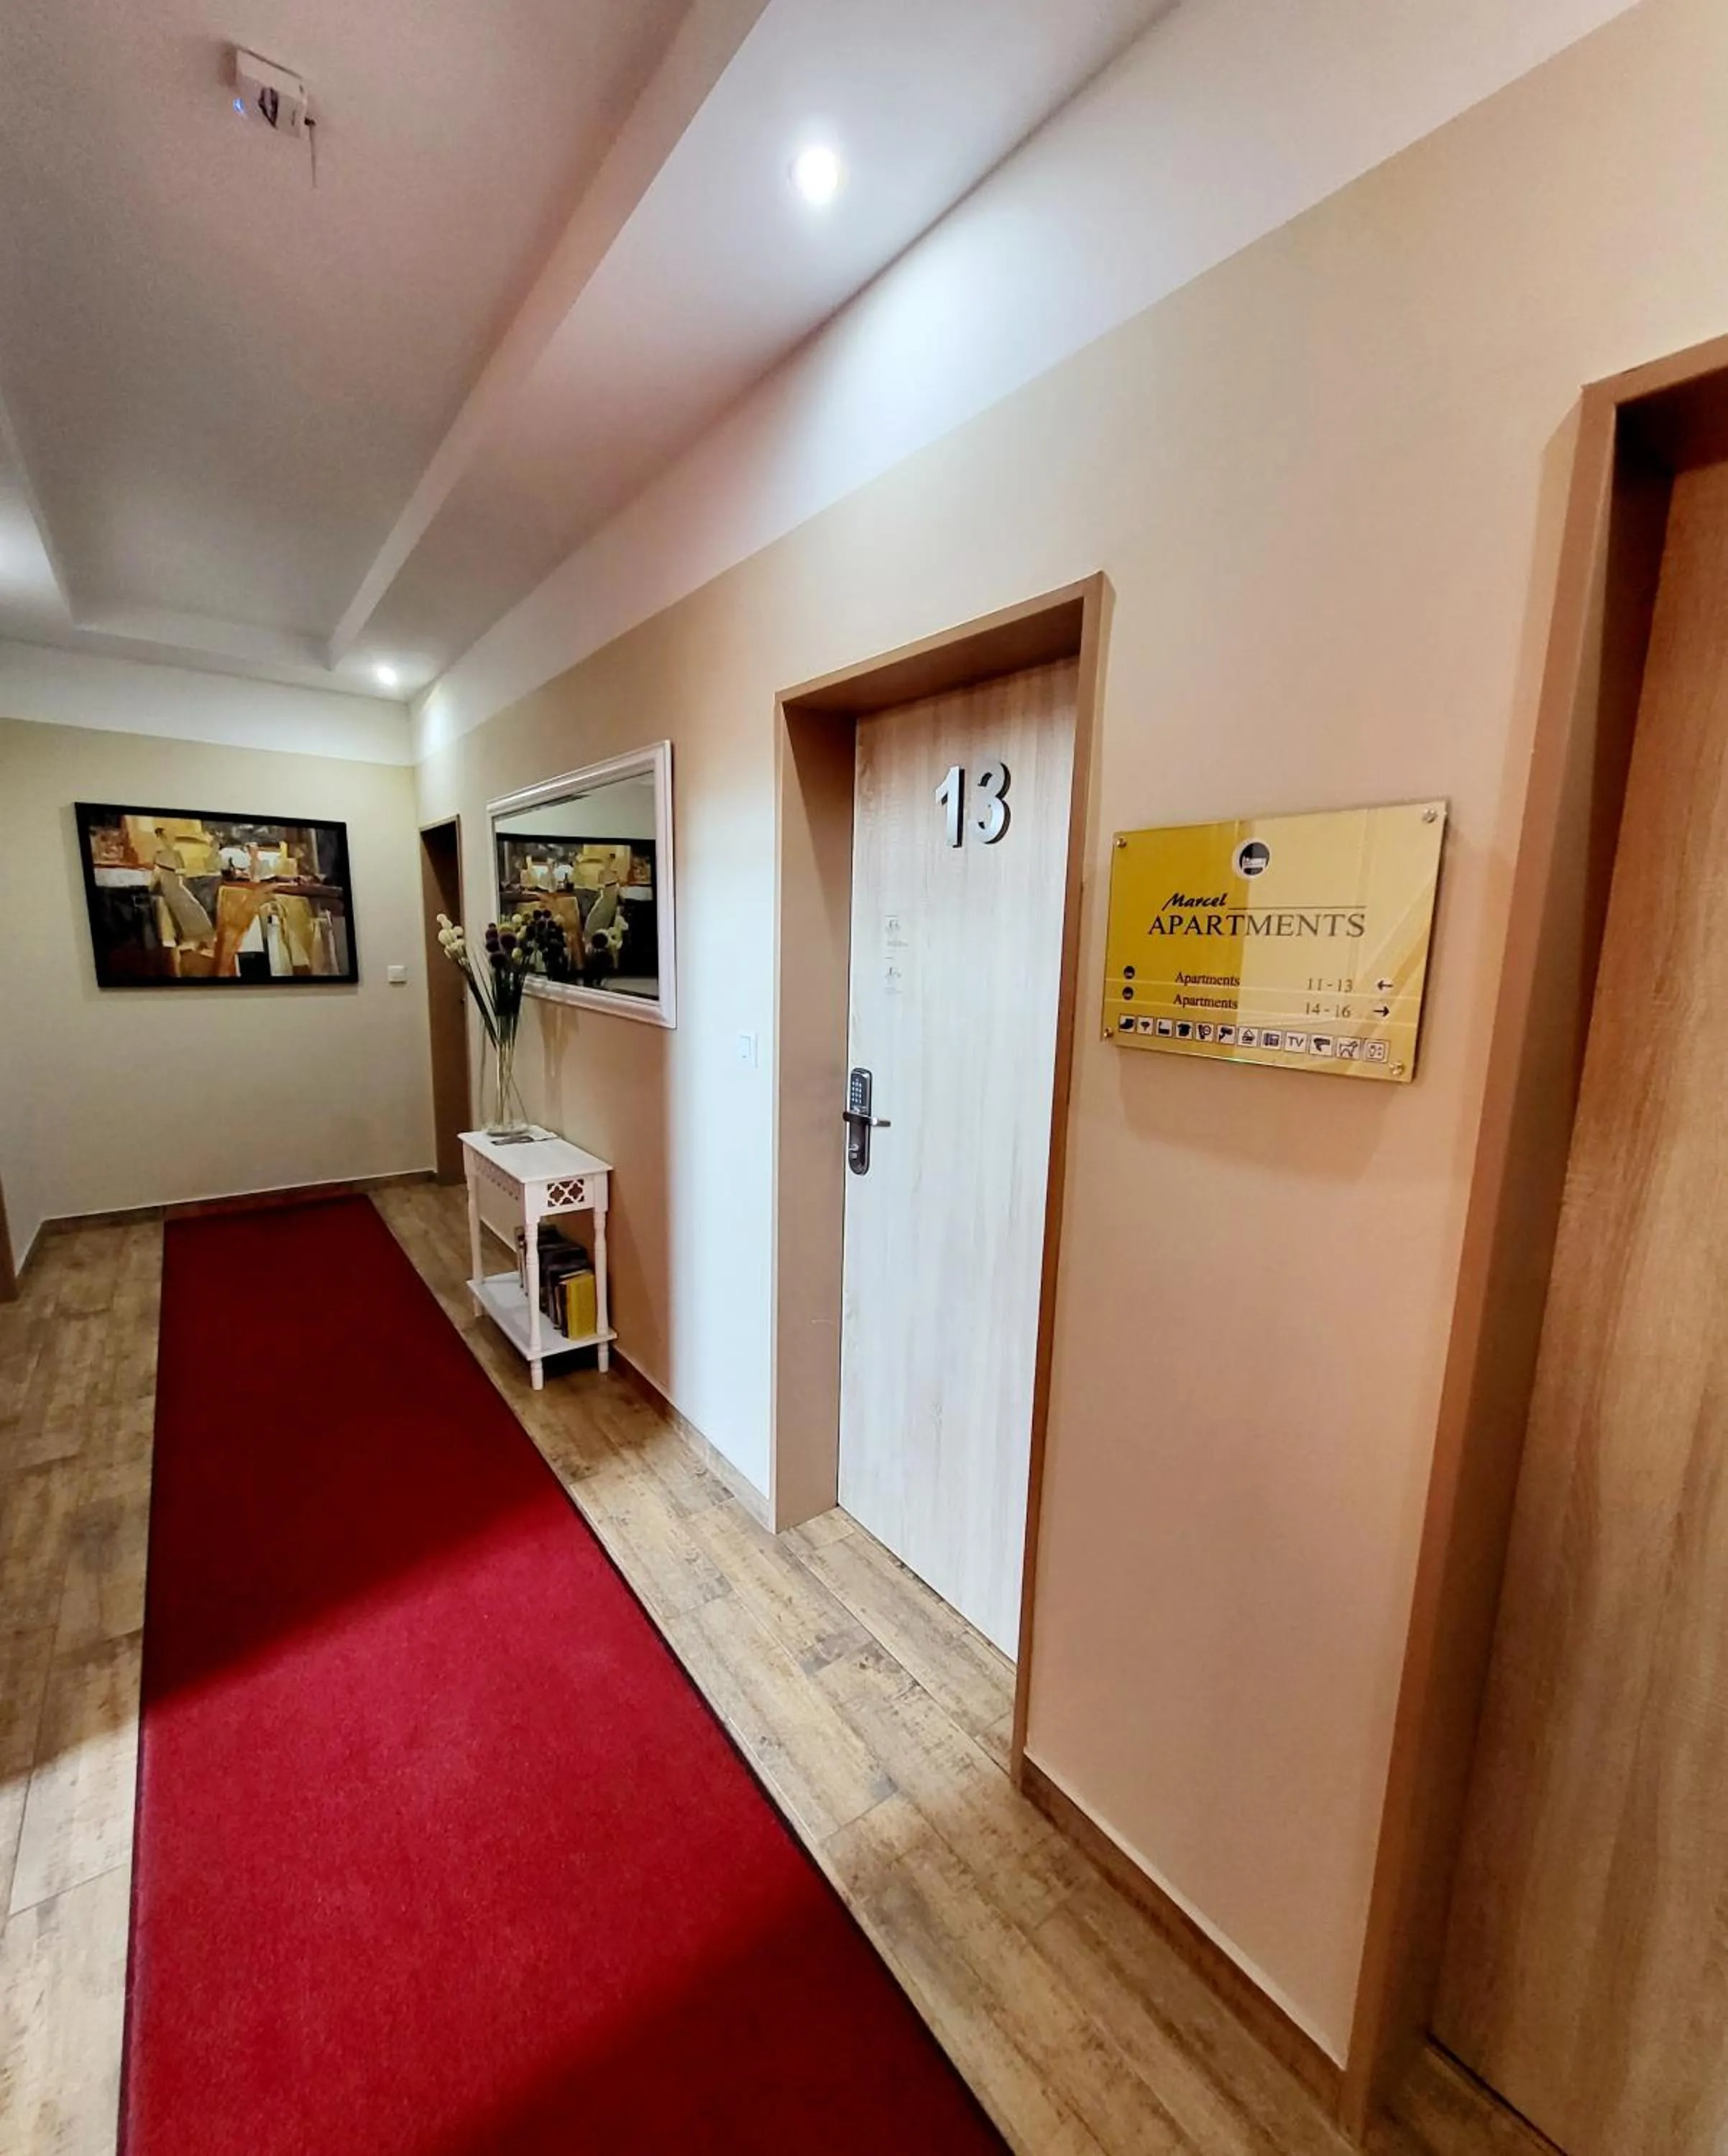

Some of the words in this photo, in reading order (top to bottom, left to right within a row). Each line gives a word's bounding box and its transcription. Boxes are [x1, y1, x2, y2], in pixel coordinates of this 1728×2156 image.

[934, 760, 1011, 848] 13
[1162, 893, 1228, 911] Marcel
[1148, 913, 1366, 938] APARTMENTS
[1175, 972, 1241, 987] Apartments
[1173, 994, 1238, 1009] Apartments
[1288, 1036, 1304, 1047] TV
